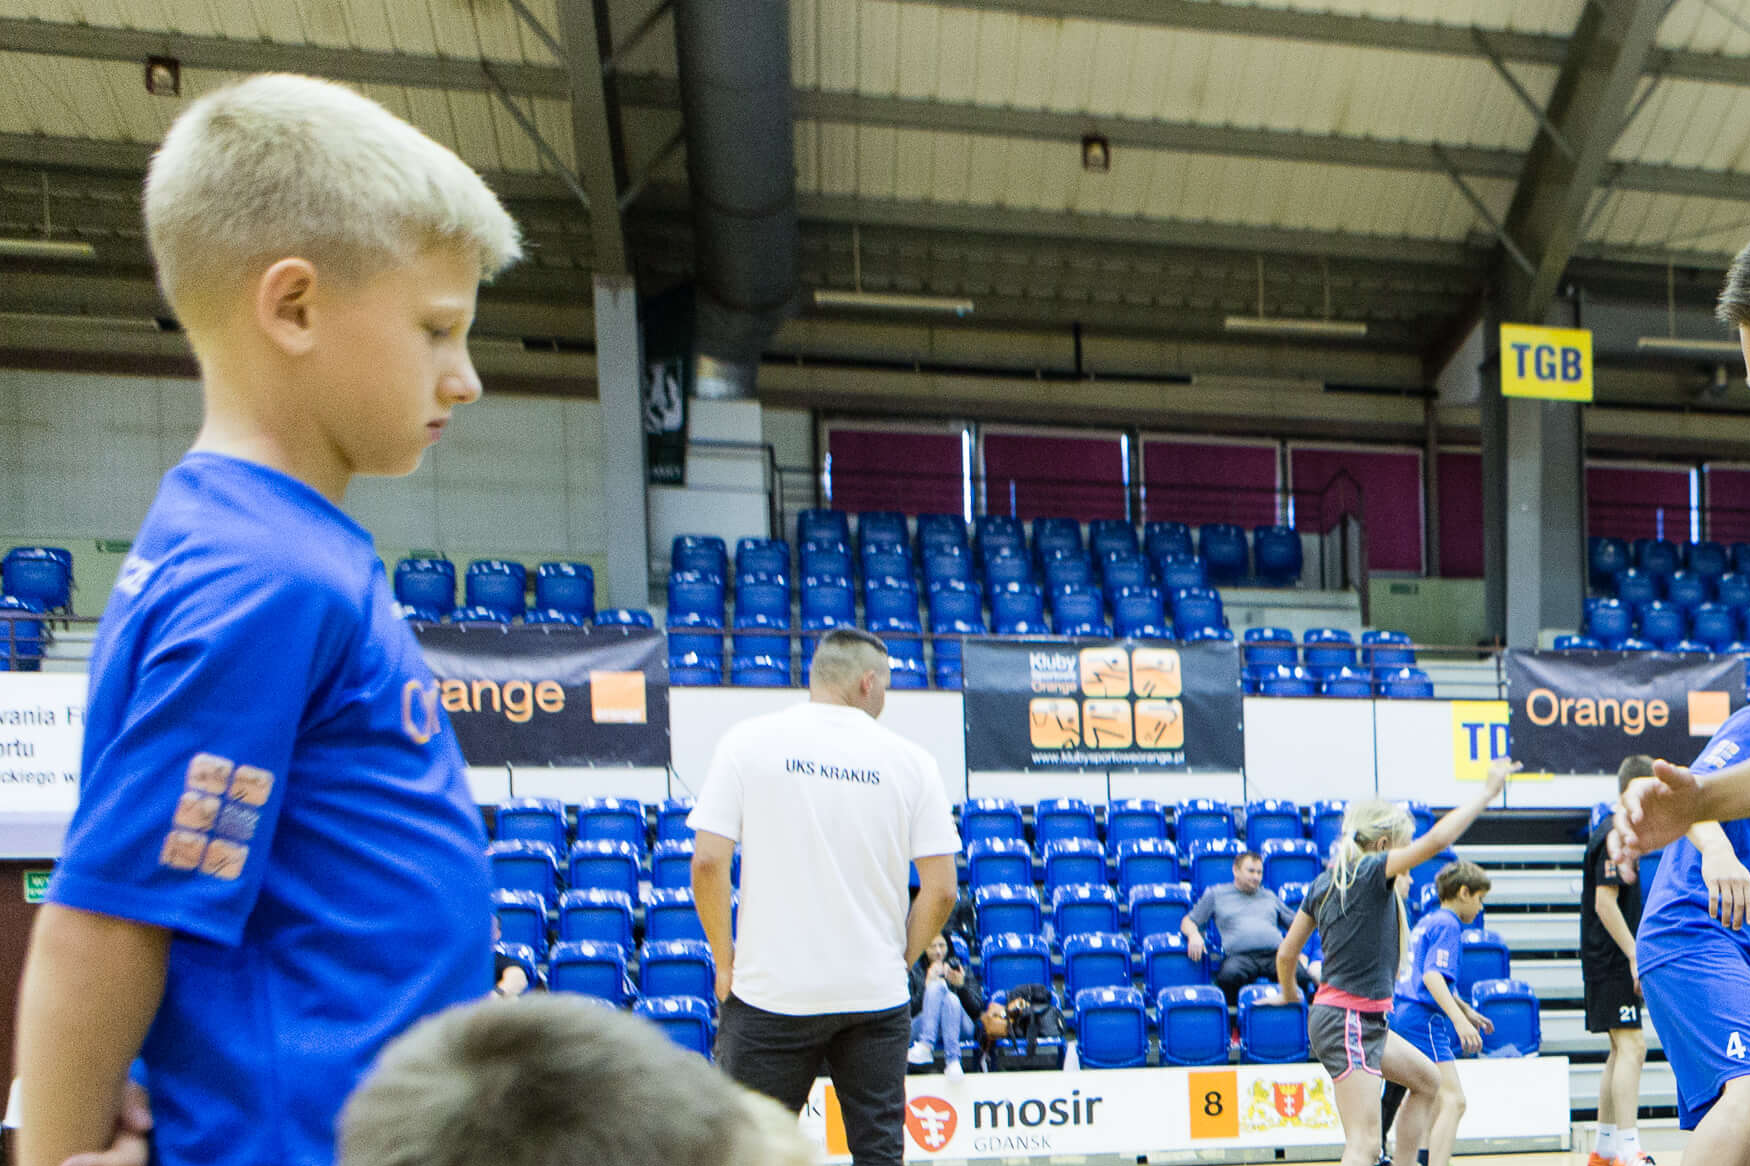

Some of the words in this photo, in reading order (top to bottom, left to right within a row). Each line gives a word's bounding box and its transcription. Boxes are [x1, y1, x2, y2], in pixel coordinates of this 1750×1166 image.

[1511, 343, 1583, 383] TGB
[1526, 688, 1670, 736] Orange
[785, 758, 815, 776] UKS
[820, 764, 881, 786] KRAKUS
[1619, 1005, 1638, 1024] 21
[1726, 1031, 1747, 1059] 4
[973, 1089, 1103, 1130] mosir
[1204, 1091, 1225, 1118] 8
